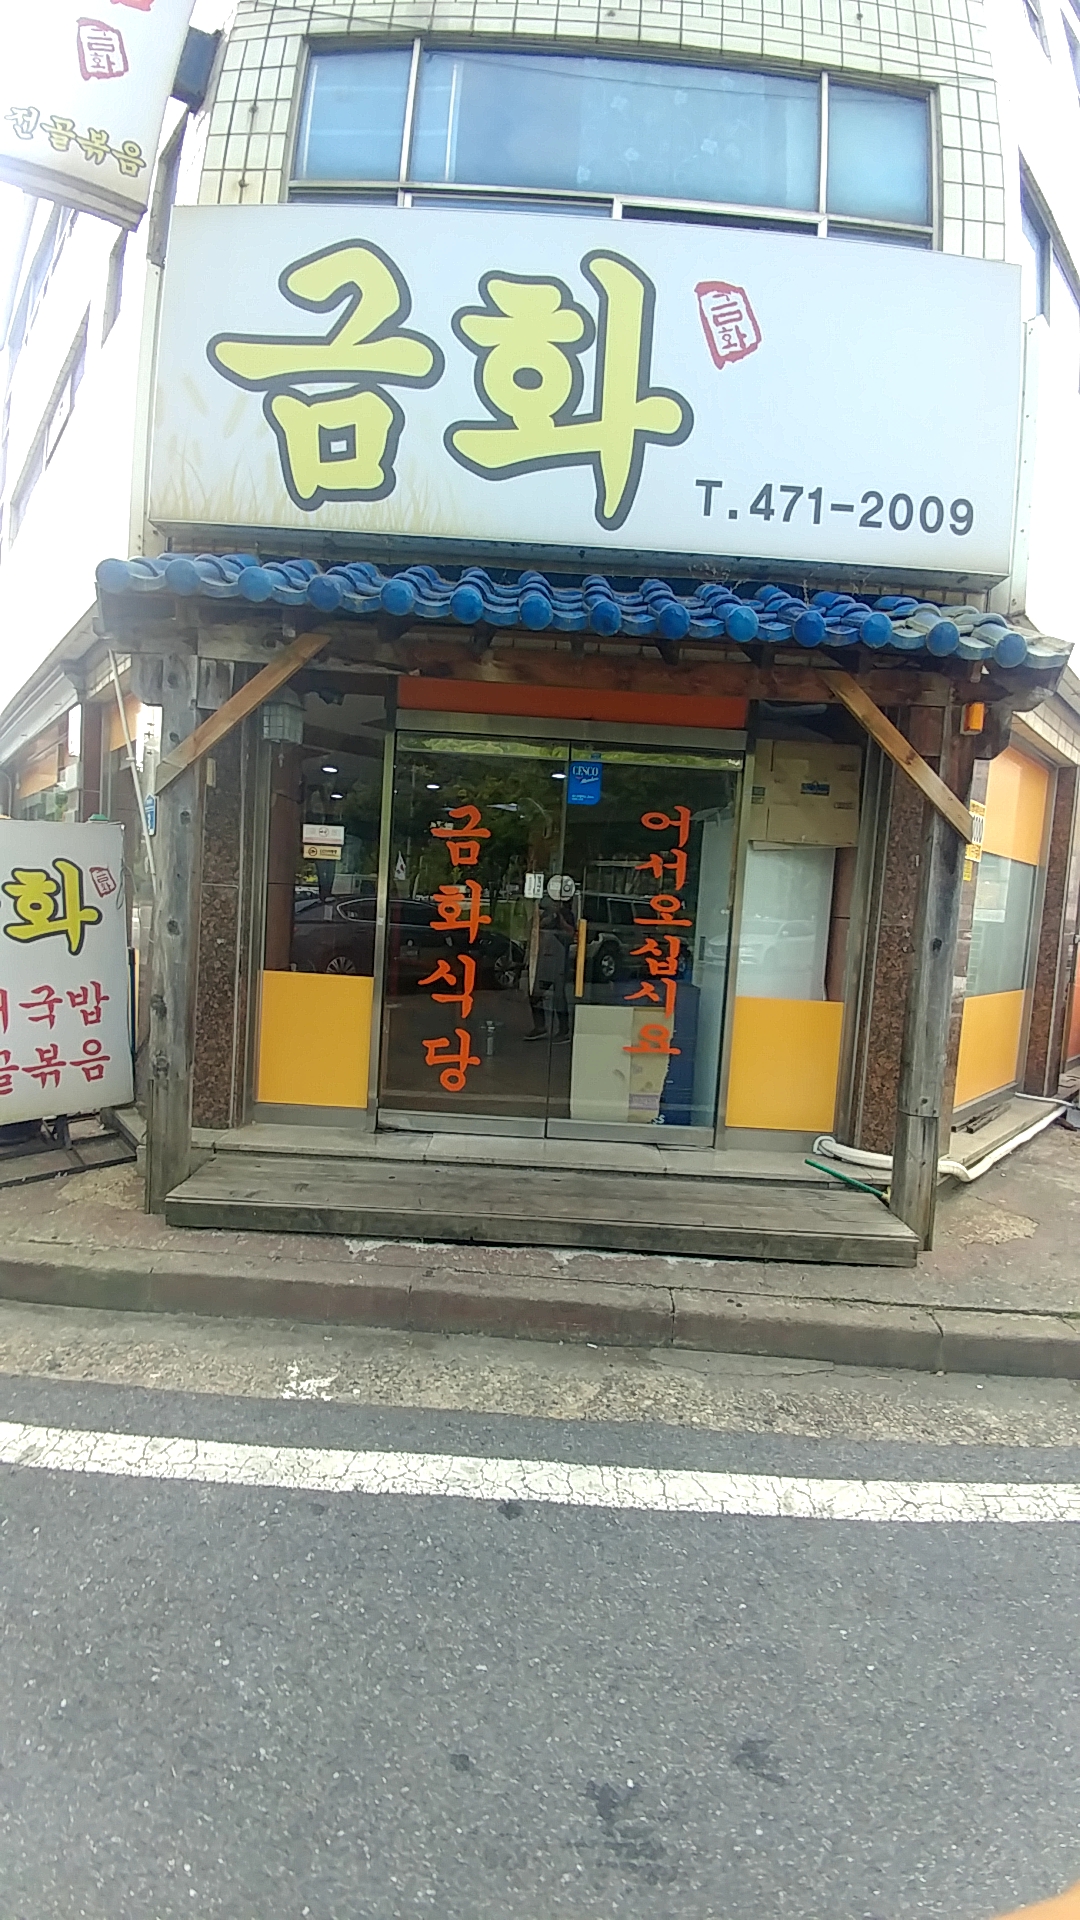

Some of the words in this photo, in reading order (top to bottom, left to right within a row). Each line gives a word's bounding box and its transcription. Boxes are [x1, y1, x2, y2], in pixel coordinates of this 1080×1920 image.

[4, 106, 147, 178] 전골볶음
[206, 238, 694, 531] 금화
[572, 765, 599, 777] CESCO
[0, 857, 103, 957] 화
[418, 804, 492, 1092] 금화식당
